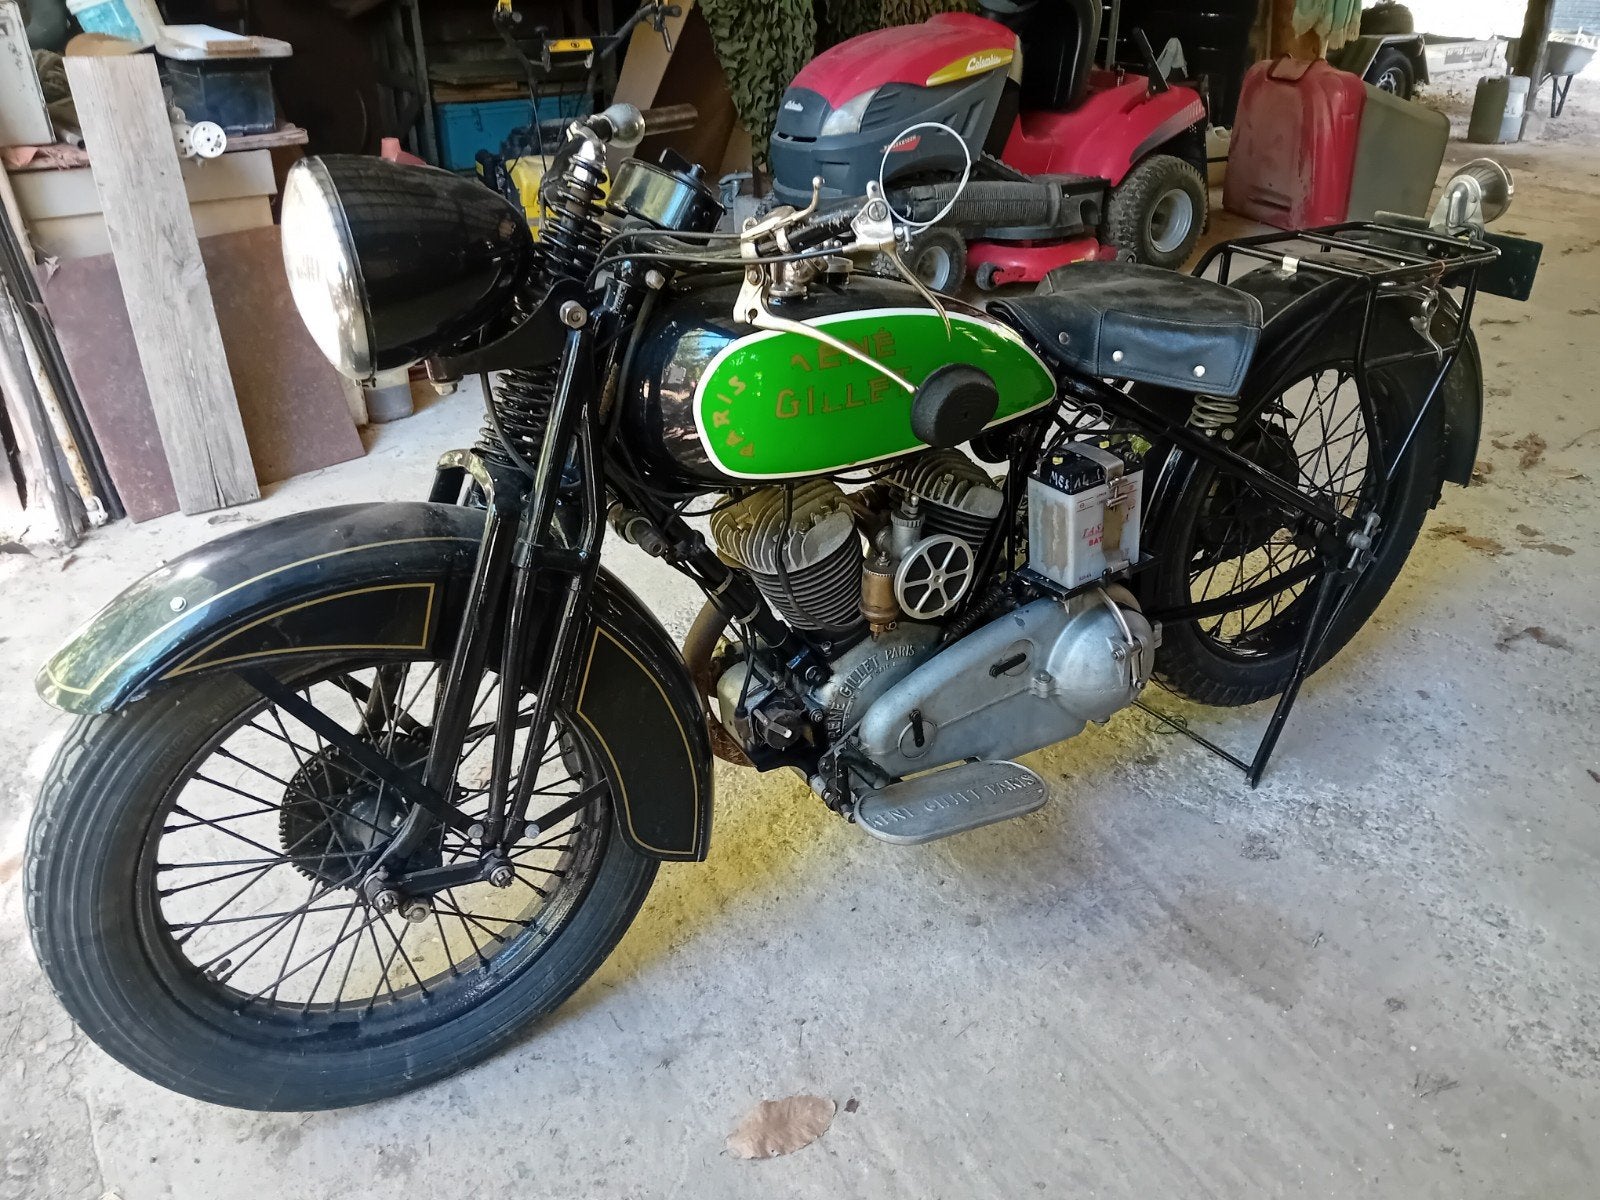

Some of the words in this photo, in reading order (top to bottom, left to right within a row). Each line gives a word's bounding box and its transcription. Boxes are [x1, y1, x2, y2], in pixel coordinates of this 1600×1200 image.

[712, 375, 755, 458] PARIS
[839, 654, 879, 698] GILLET
[885, 644, 915, 661] PARIS
[984, 773, 1036, 796] PARIS
